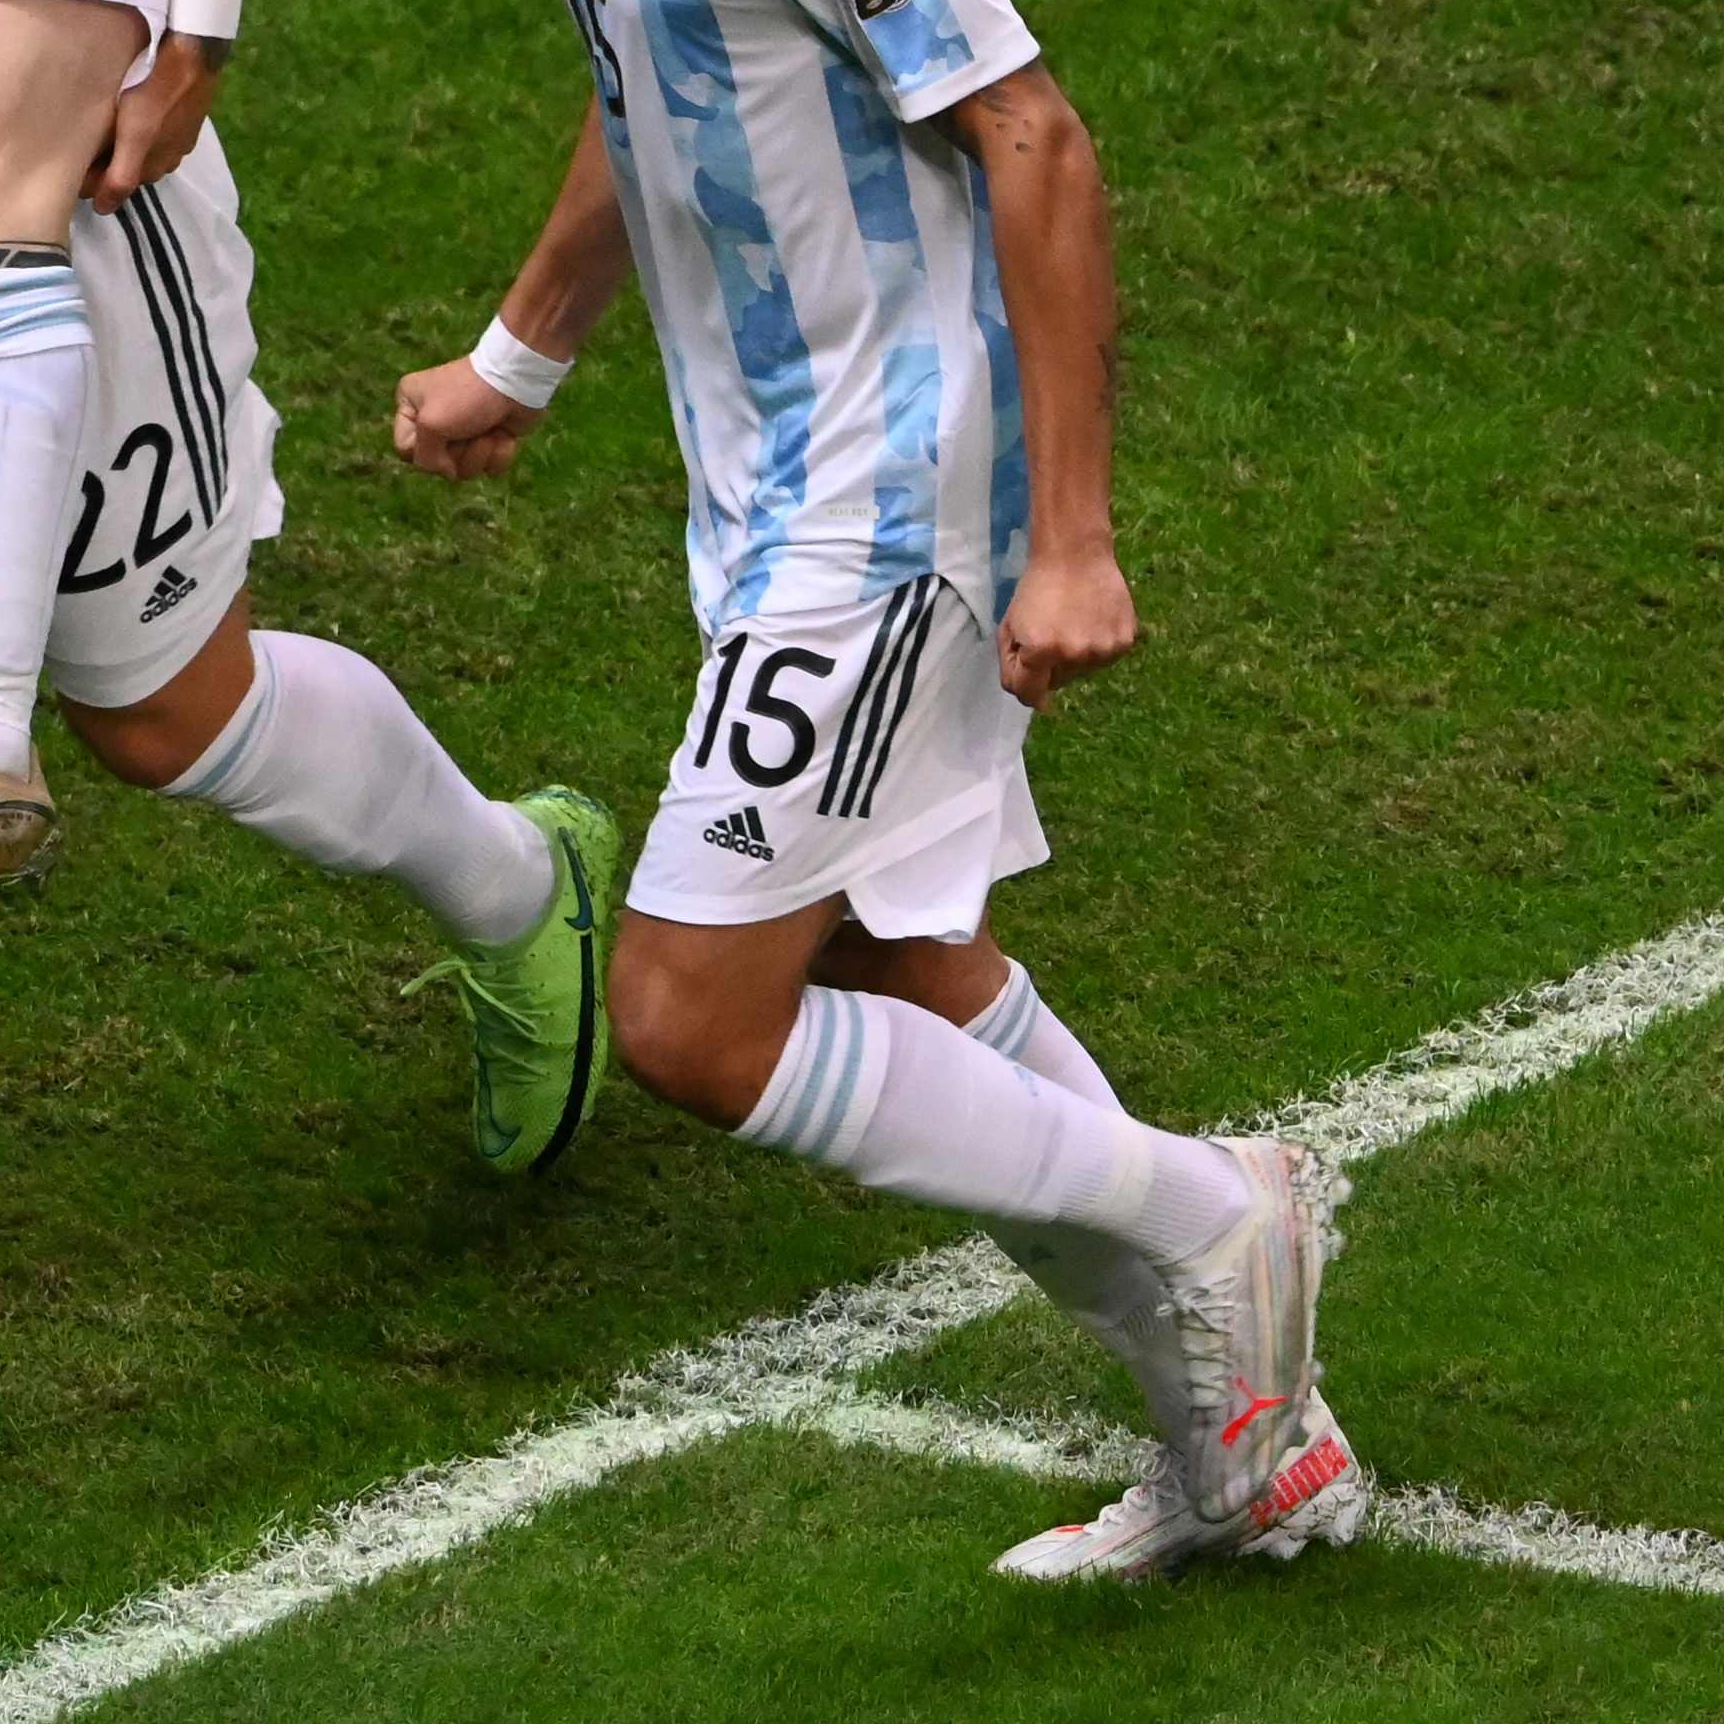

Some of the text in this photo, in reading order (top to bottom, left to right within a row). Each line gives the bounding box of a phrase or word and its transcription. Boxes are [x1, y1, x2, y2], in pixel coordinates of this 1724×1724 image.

[57, 422, 192, 595] 22
[139, 576, 198, 624] adidas
[693, 632, 837, 788] 15
[703, 827, 774, 863] adidas
